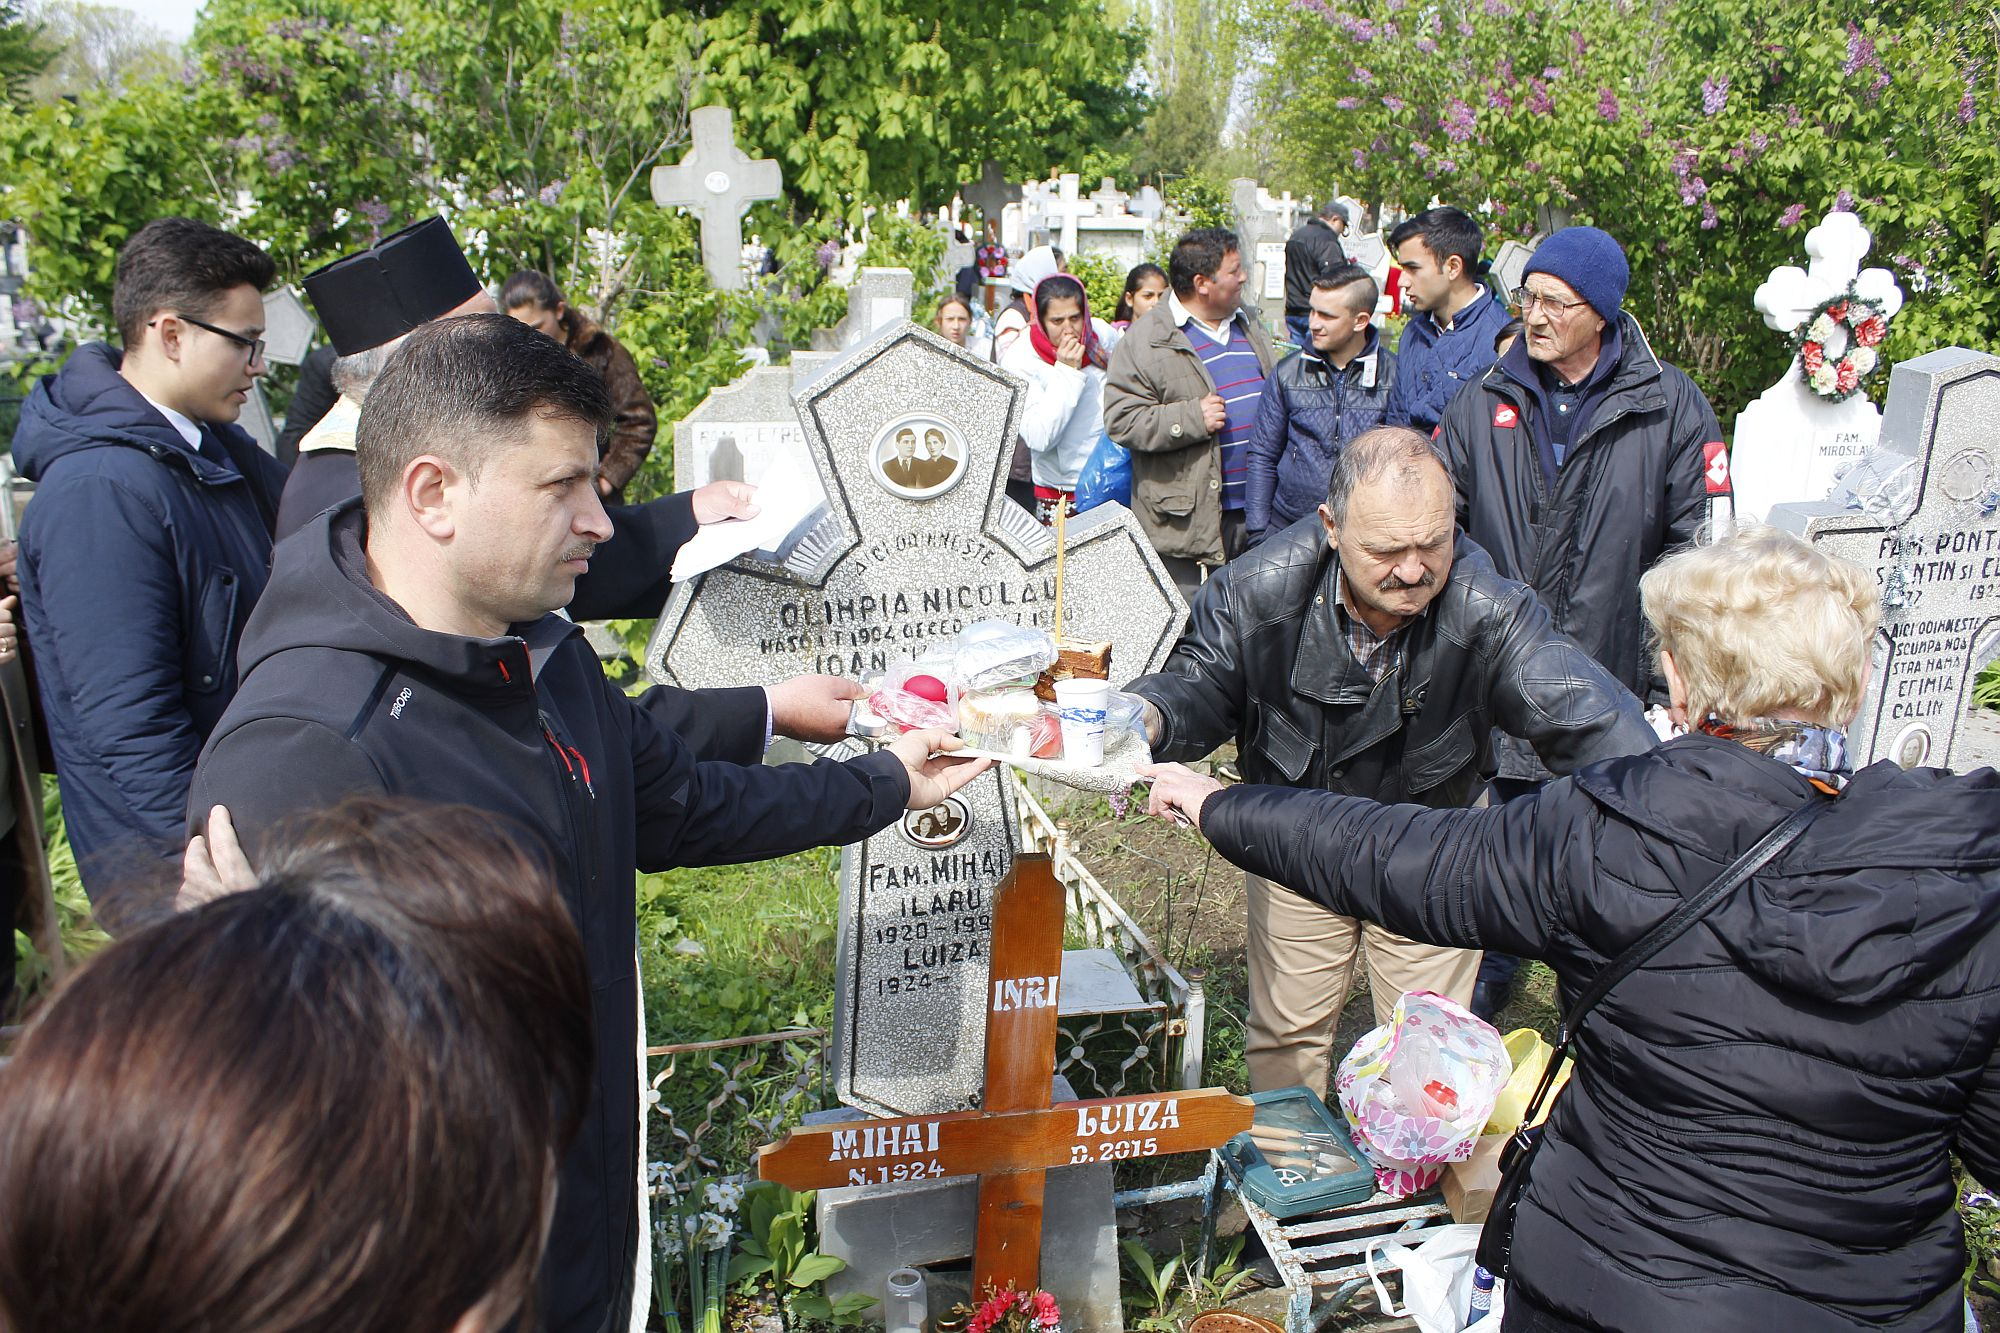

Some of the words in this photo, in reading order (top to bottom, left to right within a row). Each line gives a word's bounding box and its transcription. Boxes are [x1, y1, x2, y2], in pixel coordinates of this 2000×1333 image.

[1836, 433, 1861, 442] FAM.
[1936, 530, 2000, 554] PONT
[924, 577, 1058, 613] NICOLAU
[850, 625, 895, 646] 1904
[1891, 623, 1915, 638] AICI
[816, 651, 887, 676] IOAN
[1892, 661, 1921, 675] STRA
[1892, 700, 1943, 719] CALIN
[904, 940, 981, 970] LUIZA
[993, 976, 1059, 1011] INRI
[829, 1122, 940, 1161] MIHAI
[1077, 1099, 1179, 1136] LUIZA
[1100, 1138, 1157, 1160] 2015
